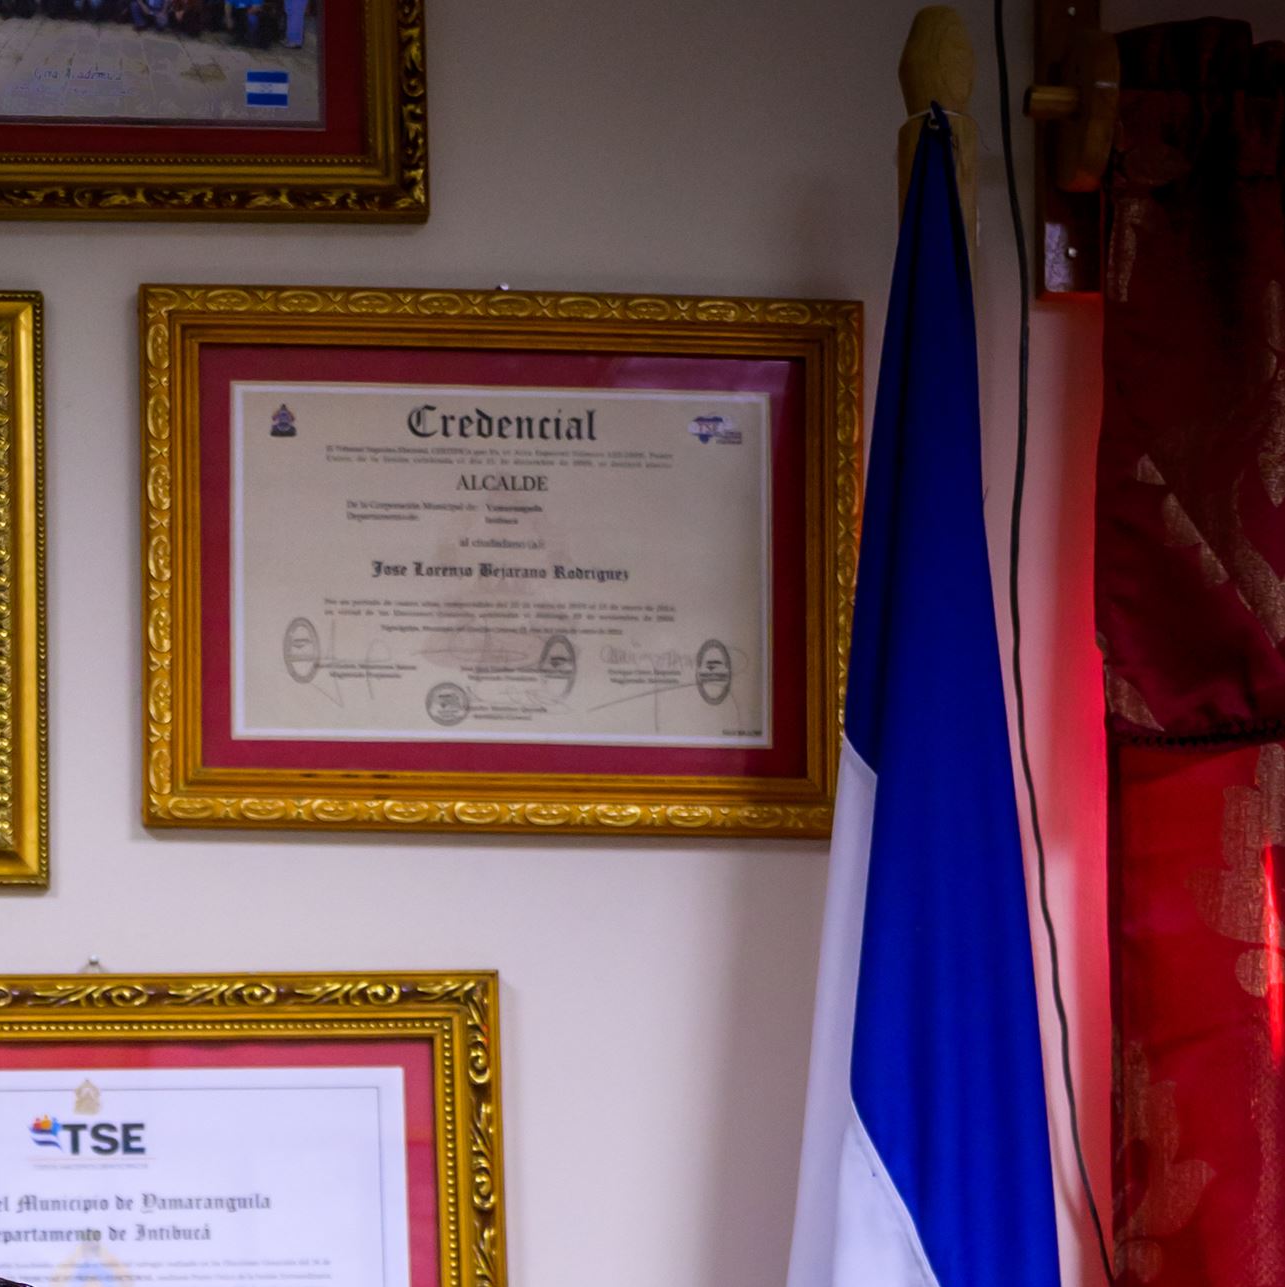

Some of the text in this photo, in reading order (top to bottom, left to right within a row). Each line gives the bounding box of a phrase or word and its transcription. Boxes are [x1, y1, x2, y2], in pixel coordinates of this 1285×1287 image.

[407, 404, 597, 441] Credencial
[456, 475, 548, 491] ALCALDE
[371, 561, 630, 583] Jose Lorenzo Bejarano Rodriguez
[63, 1122, 146, 1154] TSE
[18, 1195, 108, 1214] Municipio
[116, 1195, 134, 1211] de
[142, 1192, 271, 1214] Yamaranguila
[108, 1225, 127, 1242] de
[135, 1223, 211, 1242] Intibucá
